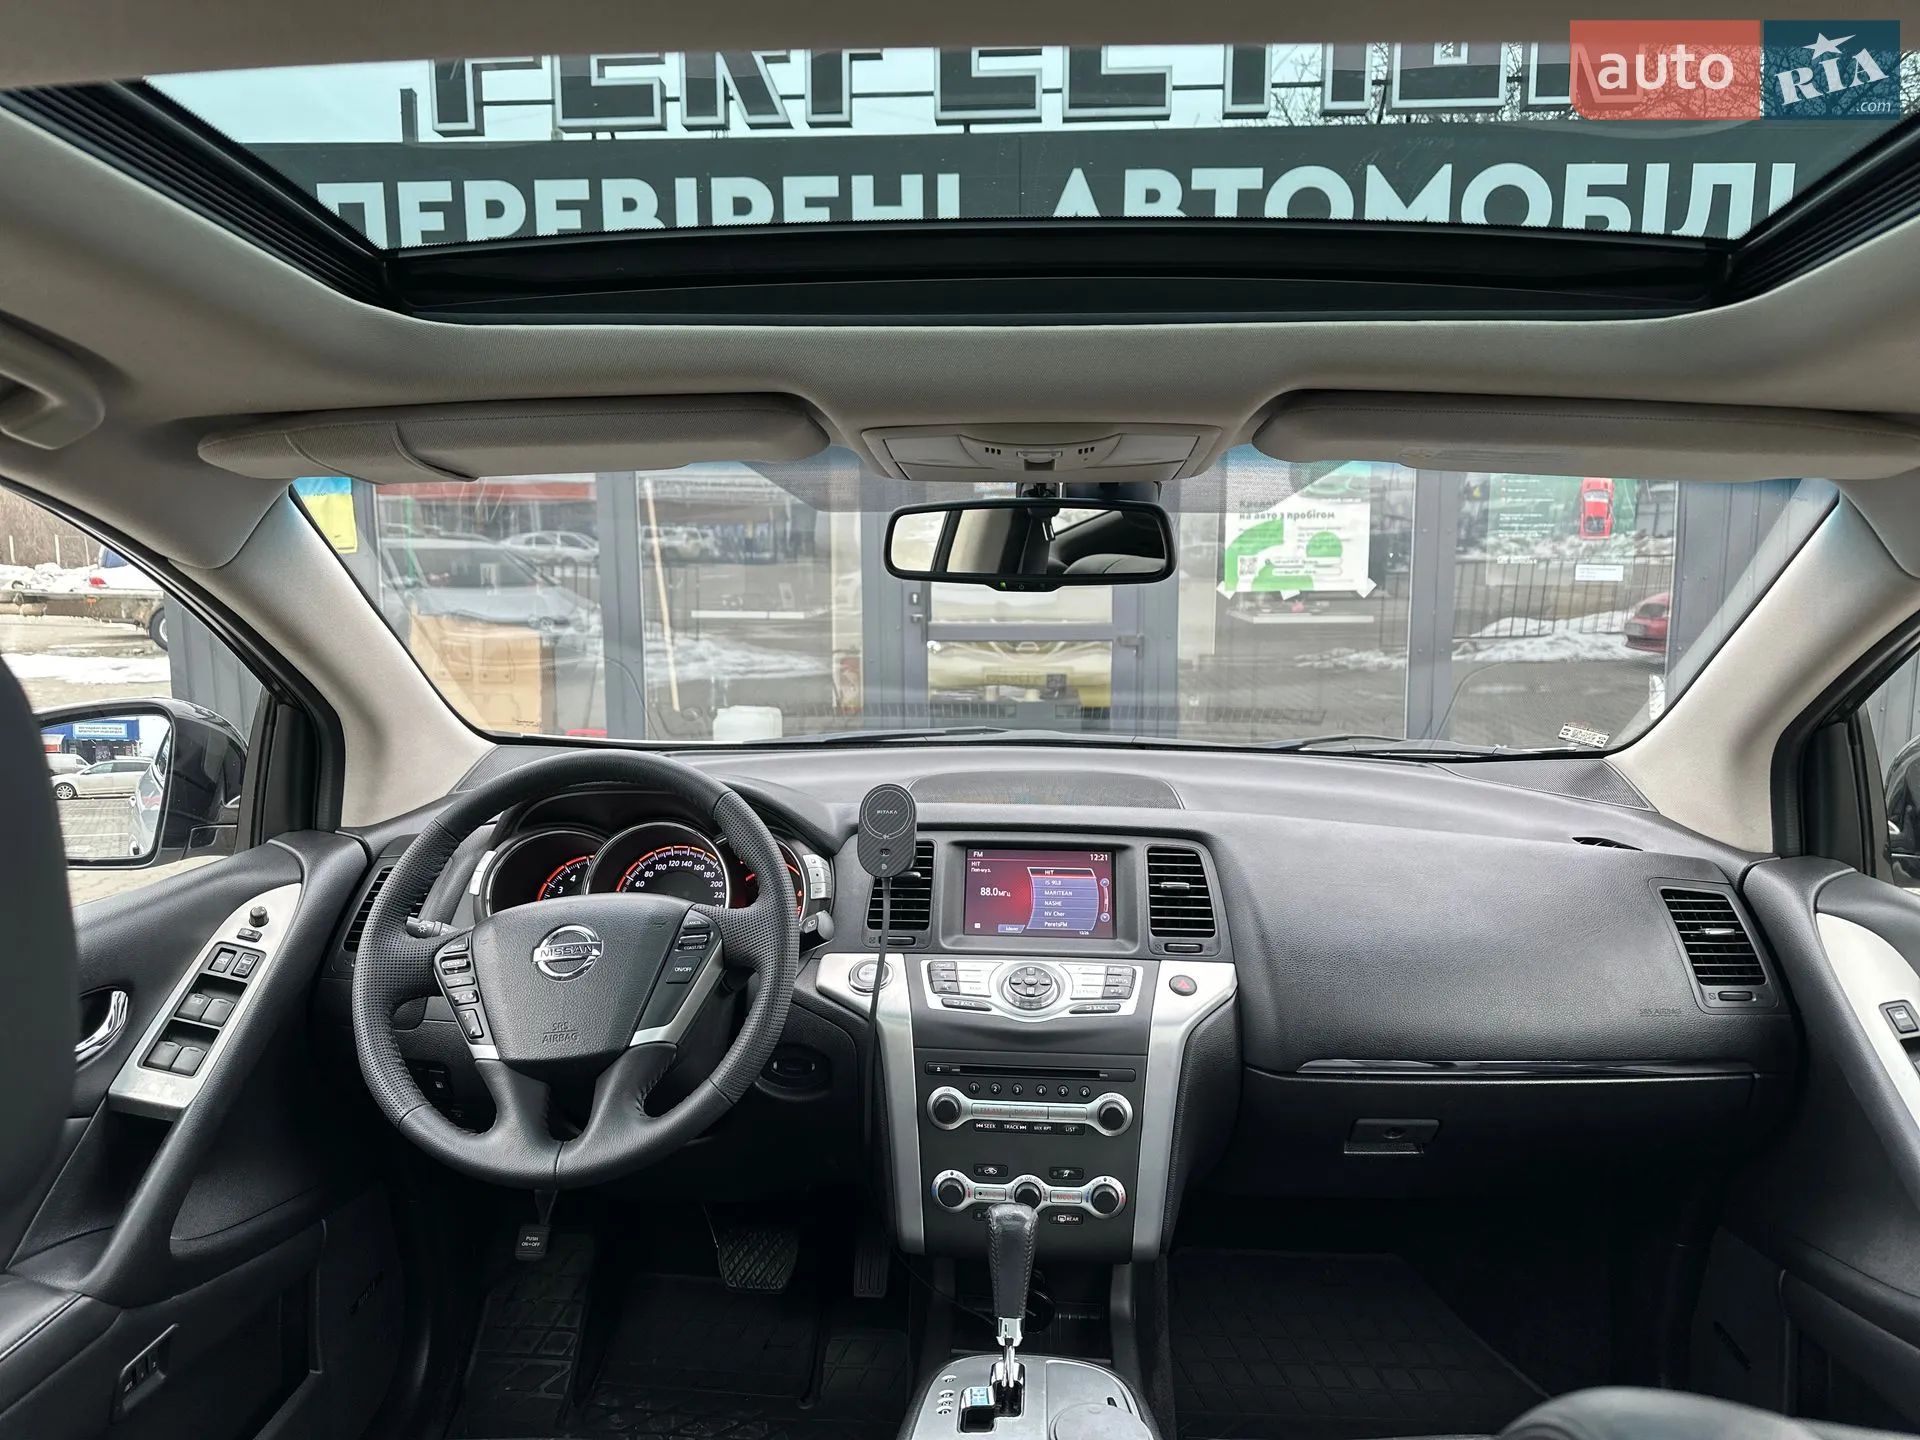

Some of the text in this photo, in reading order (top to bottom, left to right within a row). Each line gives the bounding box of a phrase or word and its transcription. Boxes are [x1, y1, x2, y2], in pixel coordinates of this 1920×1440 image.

[1286, 509, 1336, 521] пробігом
[1089, 854, 1109, 862] 12:21
[668, 860, 680, 868] 120
[681, 860, 693, 868] 140
[644, 870, 654, 878] 80
[569, 875, 577, 883] 4
[635, 880, 645, 888] 60
[710, 880, 723, 888] 200
[558, 886, 564, 894] 3
[540, 944, 594, 958] NISSAN
[552, 1021, 569, 1030] SRS
[542, 1033, 579, 1043] AIRBAG
